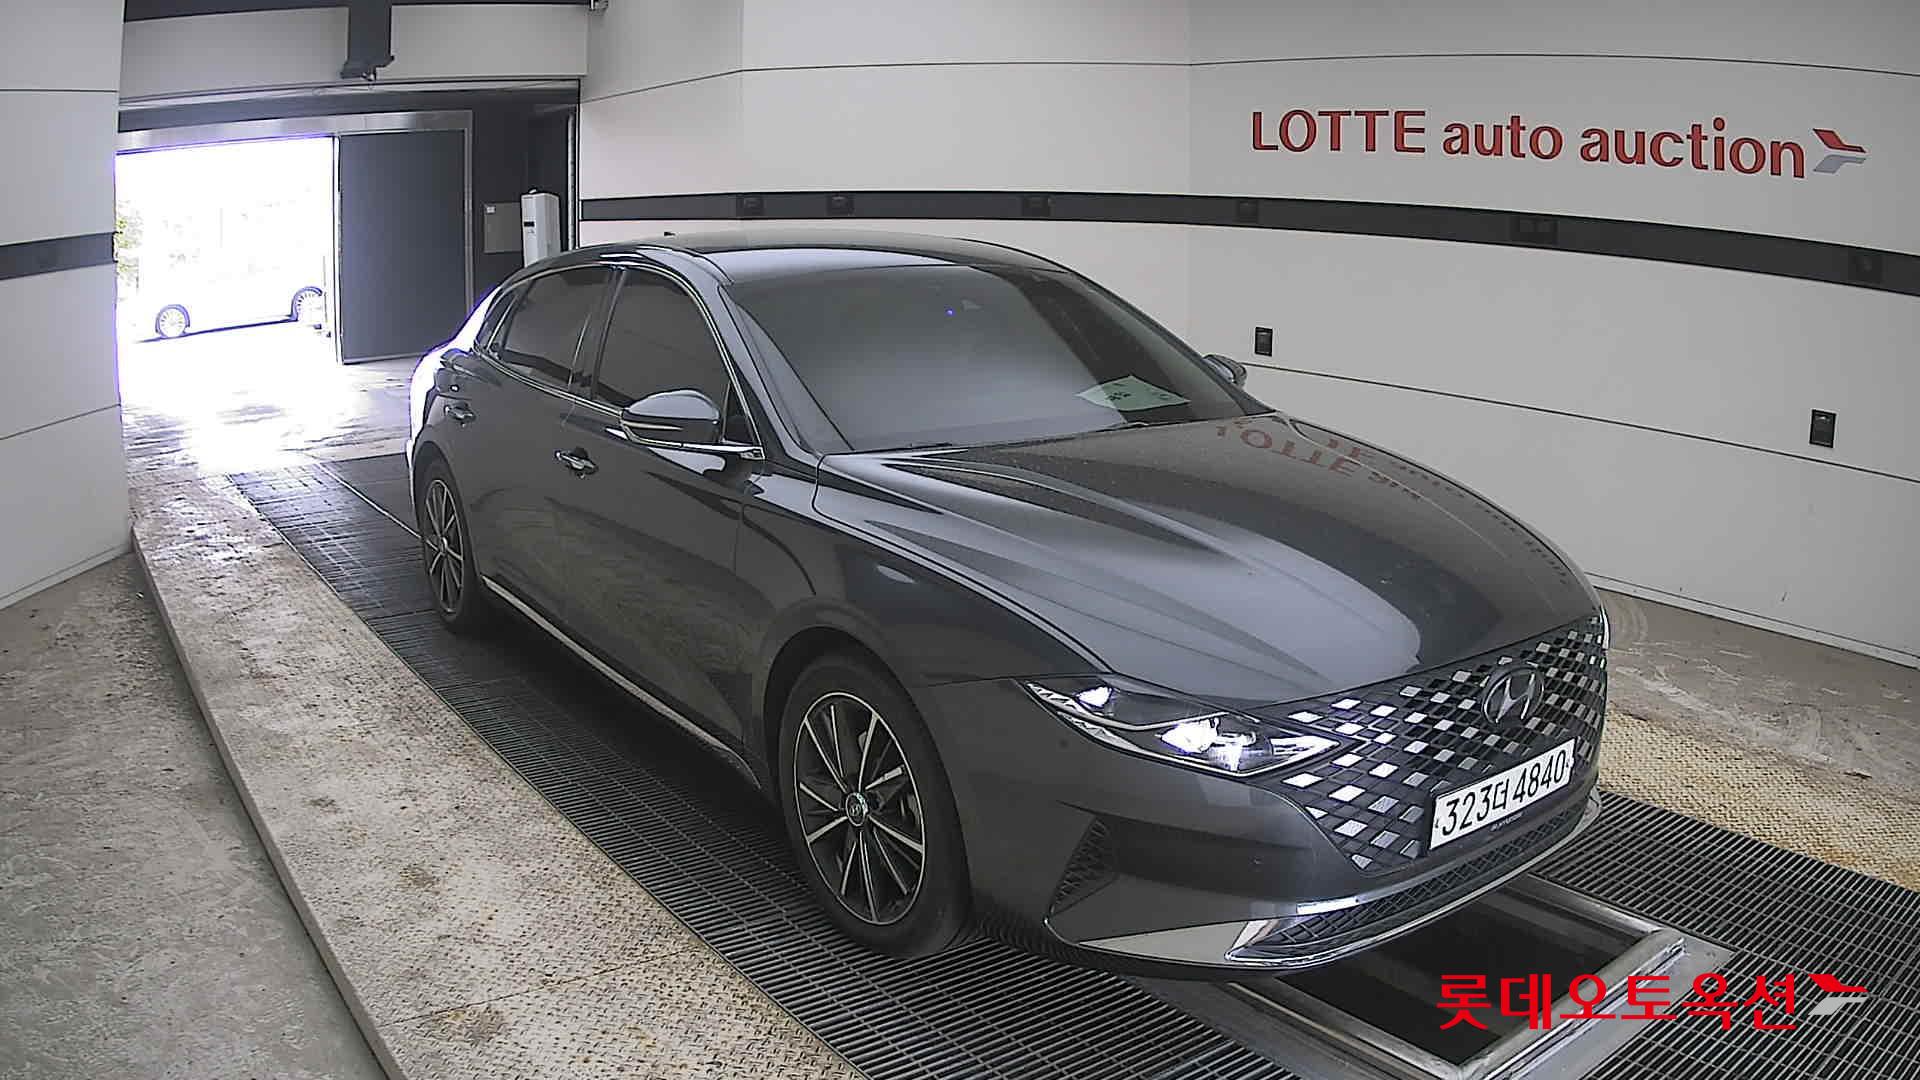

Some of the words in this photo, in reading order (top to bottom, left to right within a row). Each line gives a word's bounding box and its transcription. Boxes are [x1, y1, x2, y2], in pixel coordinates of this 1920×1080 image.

[1253, 110, 1426, 154] LOTTE
[1443, 116, 1565, 160] auto
[1581, 118, 1805, 178] auction
[1443, 779, 1510, 836] 323더
[1513, 750, 1567, 803] 4840
